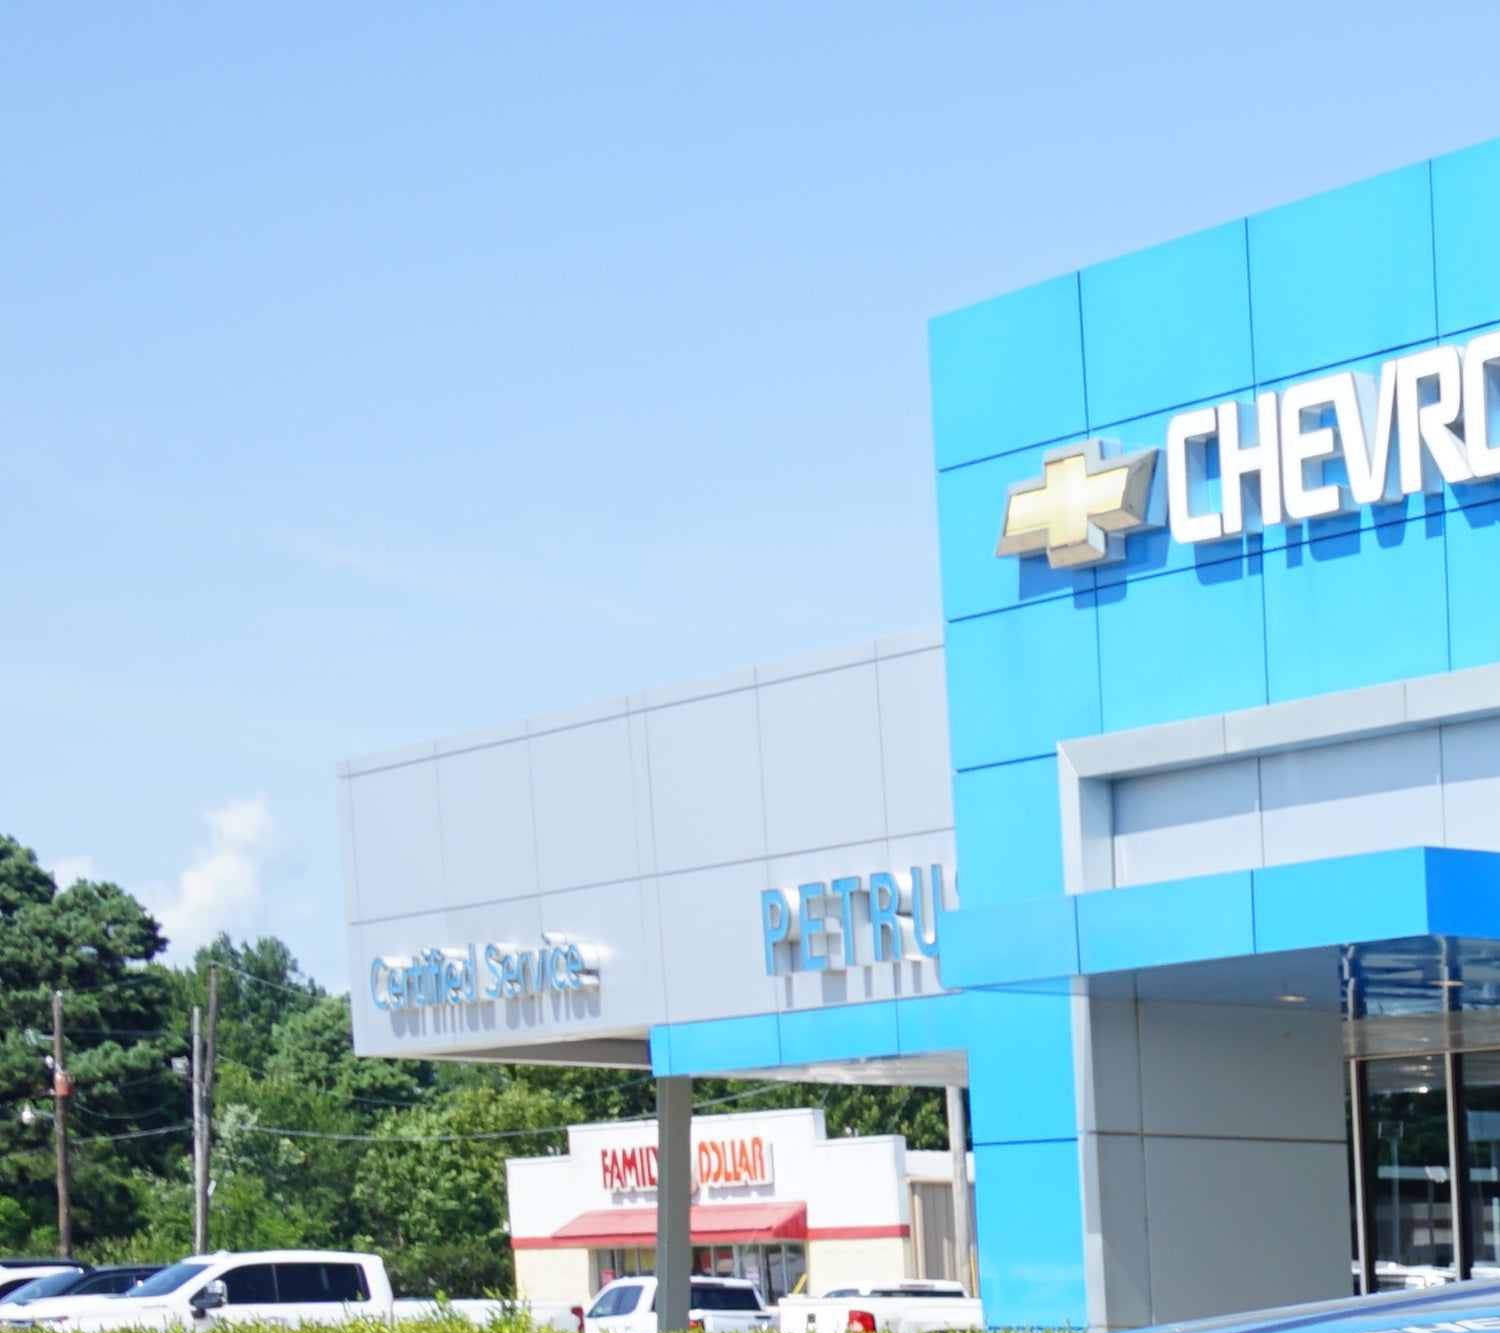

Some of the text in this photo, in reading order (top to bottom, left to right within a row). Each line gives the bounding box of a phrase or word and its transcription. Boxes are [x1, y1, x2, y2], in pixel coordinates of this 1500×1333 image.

[760, 863, 960, 976] PETRU
[370, 931, 590, 1012] Certified Service
[601, 1136, 767, 1190] FAMIL DOLLAR
